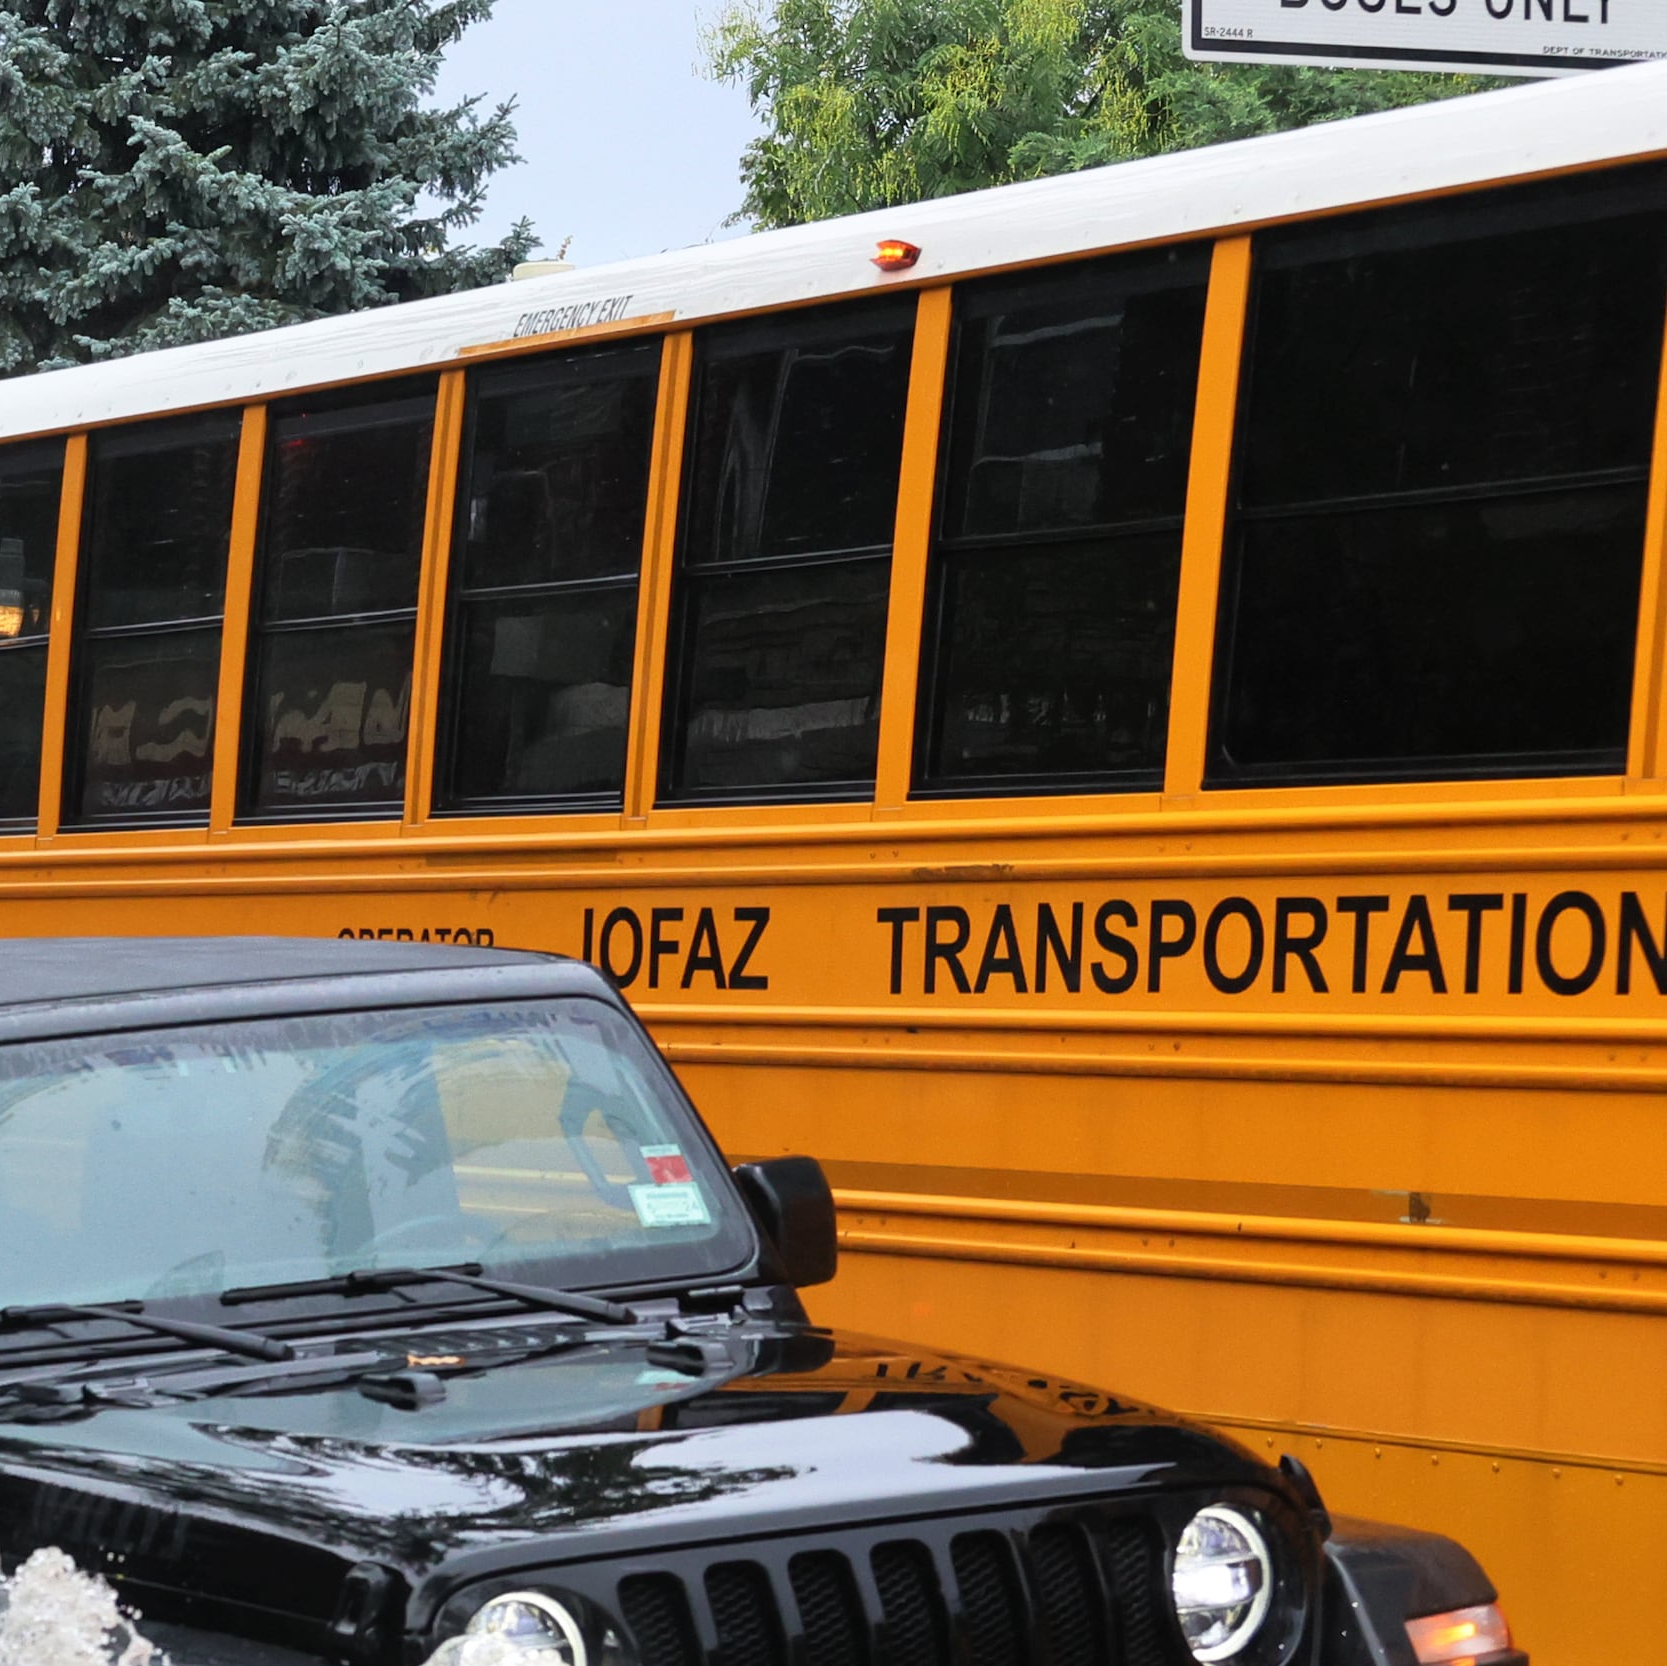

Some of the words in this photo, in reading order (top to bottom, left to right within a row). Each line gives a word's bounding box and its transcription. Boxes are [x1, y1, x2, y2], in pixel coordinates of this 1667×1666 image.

[1204, 26, 1244, 37] SR-2444
[1542, 46, 1568, 55] DEPT
[1573, 47, 1584, 55] OF
[513, 300, 603, 337] EMERGENCY
[596, 294, 634, 325] EXIT
[877, 890, 1667, 996] TRANSPORTATION
